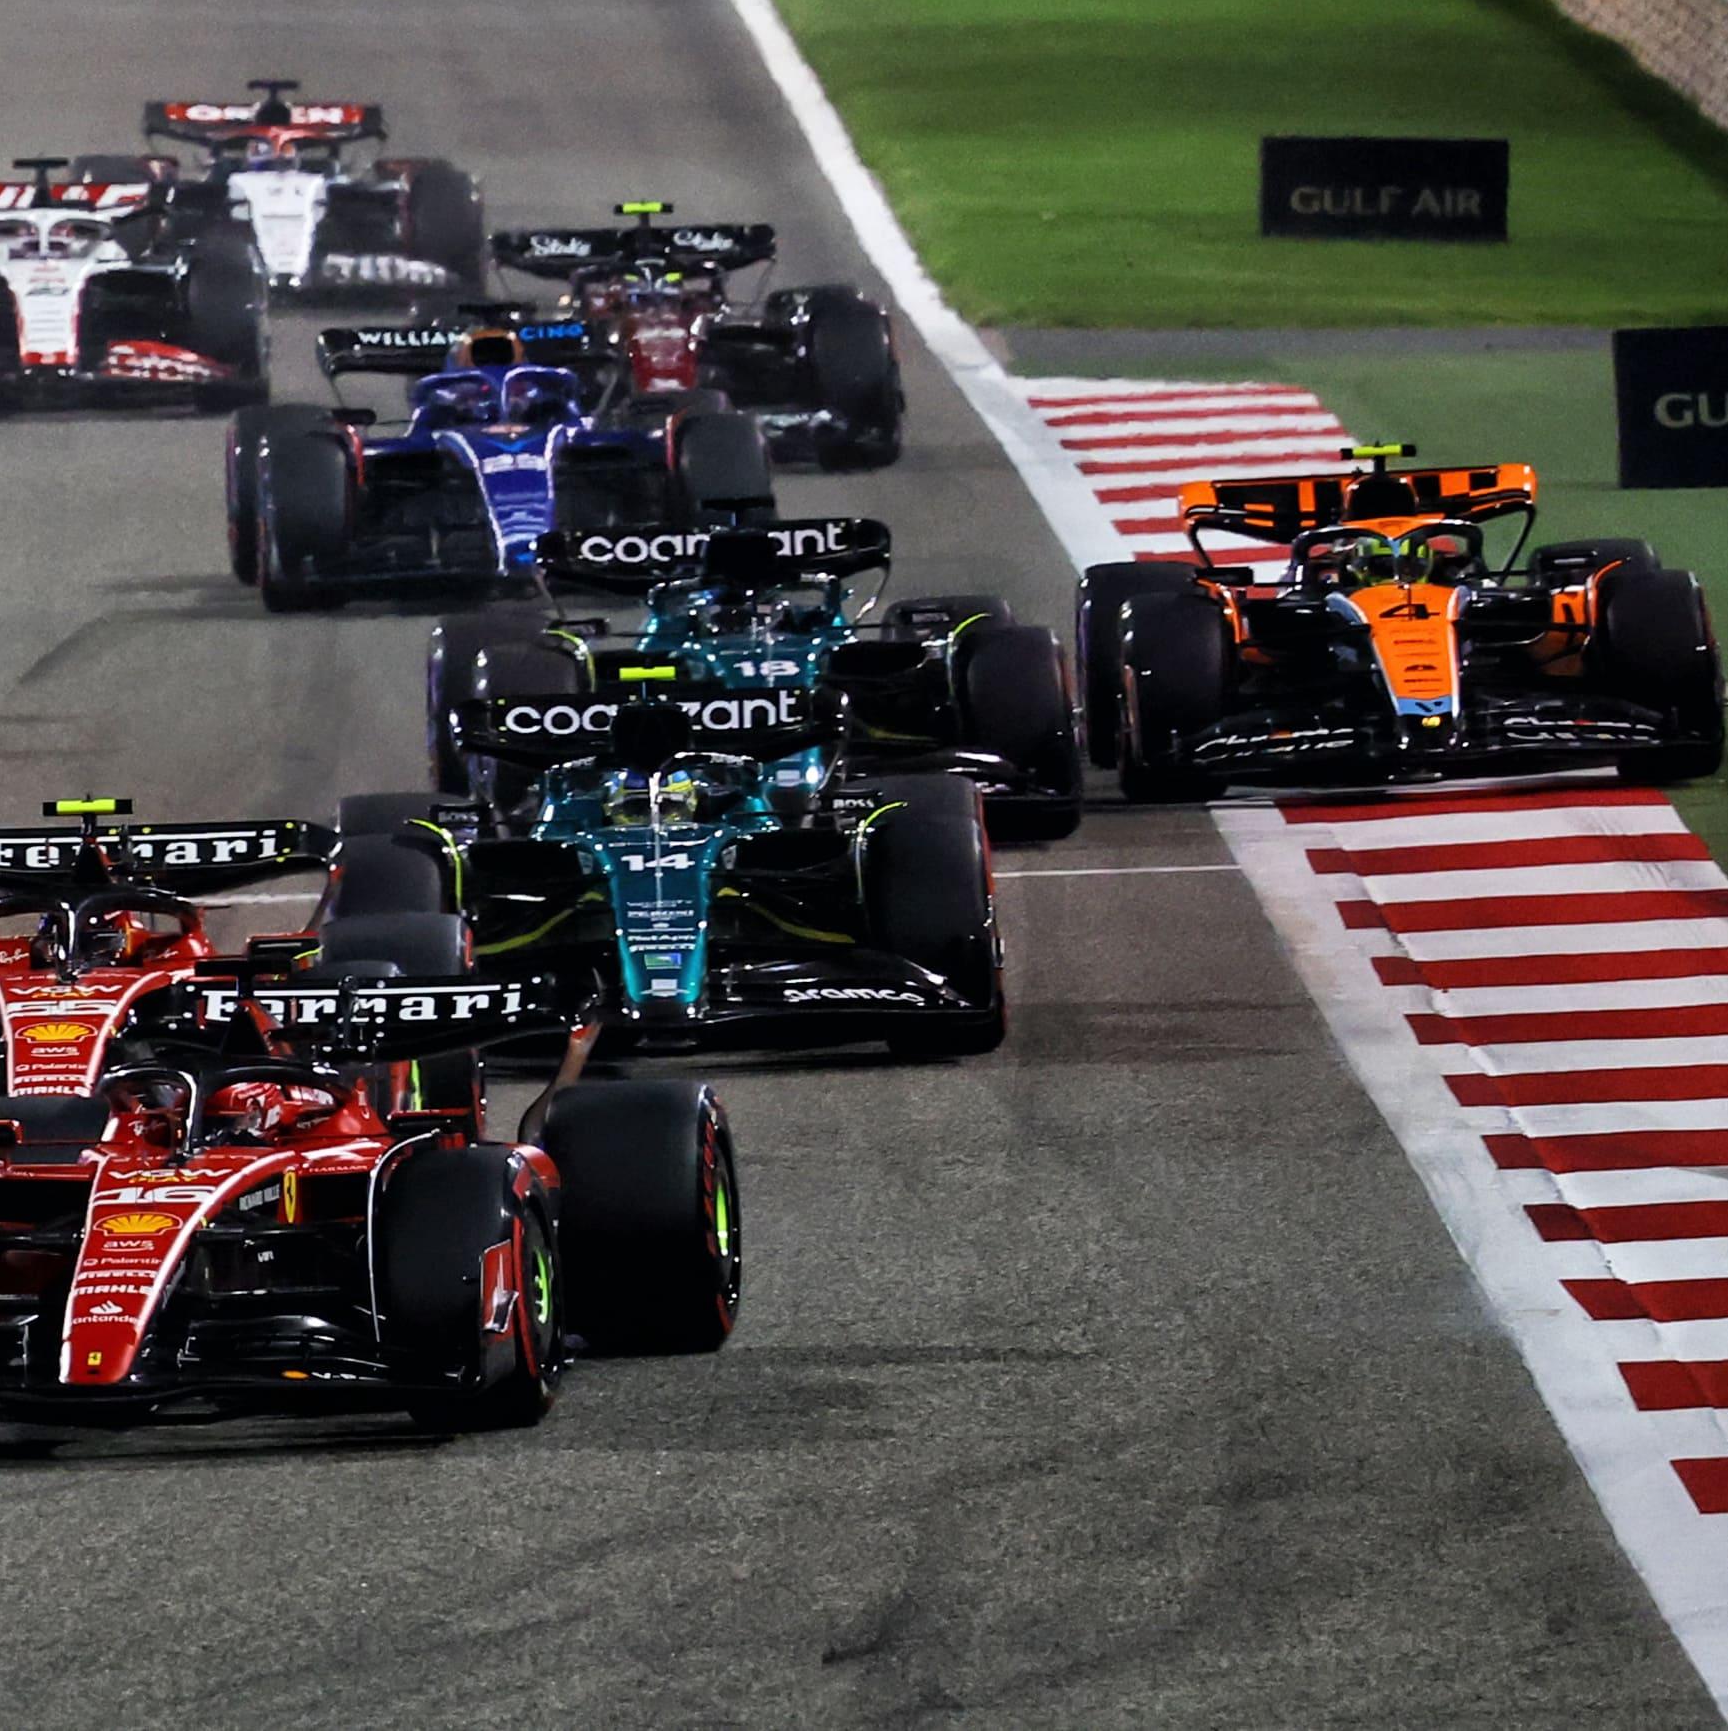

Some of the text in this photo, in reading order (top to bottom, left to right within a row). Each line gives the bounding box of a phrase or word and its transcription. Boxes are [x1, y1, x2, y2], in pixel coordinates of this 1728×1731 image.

[1290, 184, 1481, 217] GULF AIR
[1379, 603, 1442, 621] 4
[733, 660, 800, 677] 18
[620, 853, 696, 871] 14
[783, 988, 925, 1007] aramco
[6, 999, 119, 1019] 55
[31, 1046, 79, 1056] aws
[92, 1185, 218, 1205] 16
[102, 1240, 154, 1251] aws
[72, 1313, 139, 1325] antande
